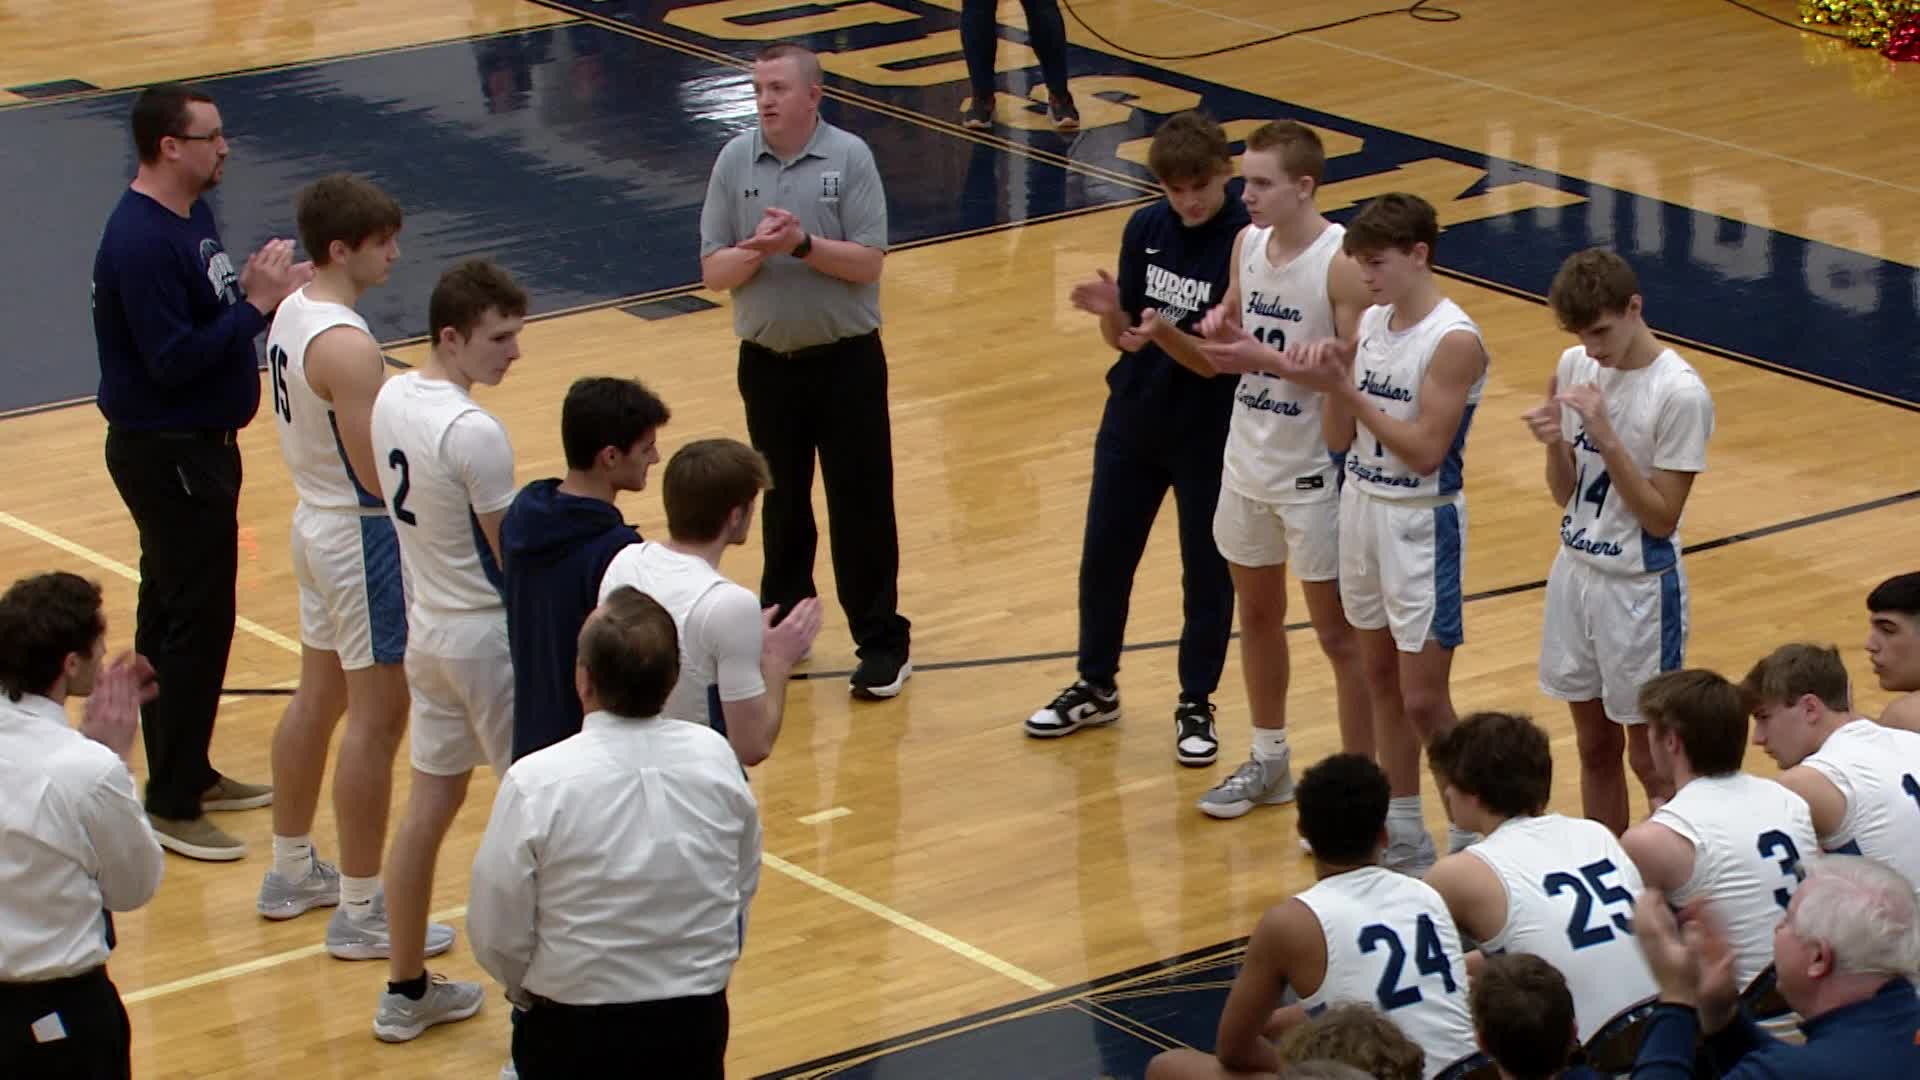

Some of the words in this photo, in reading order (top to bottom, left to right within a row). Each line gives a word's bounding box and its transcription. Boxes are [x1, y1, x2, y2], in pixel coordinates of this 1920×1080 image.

[1246, 291, 1303, 323] Hudson
[270, 343, 292, 424] 15
[1357, 369, 1413, 402] Hudson
[389, 447, 418, 527] 2
[1543, 857, 1637, 951] 25
[1757, 829, 1806, 911] 3
[1358, 913, 1457, 1012] 24
